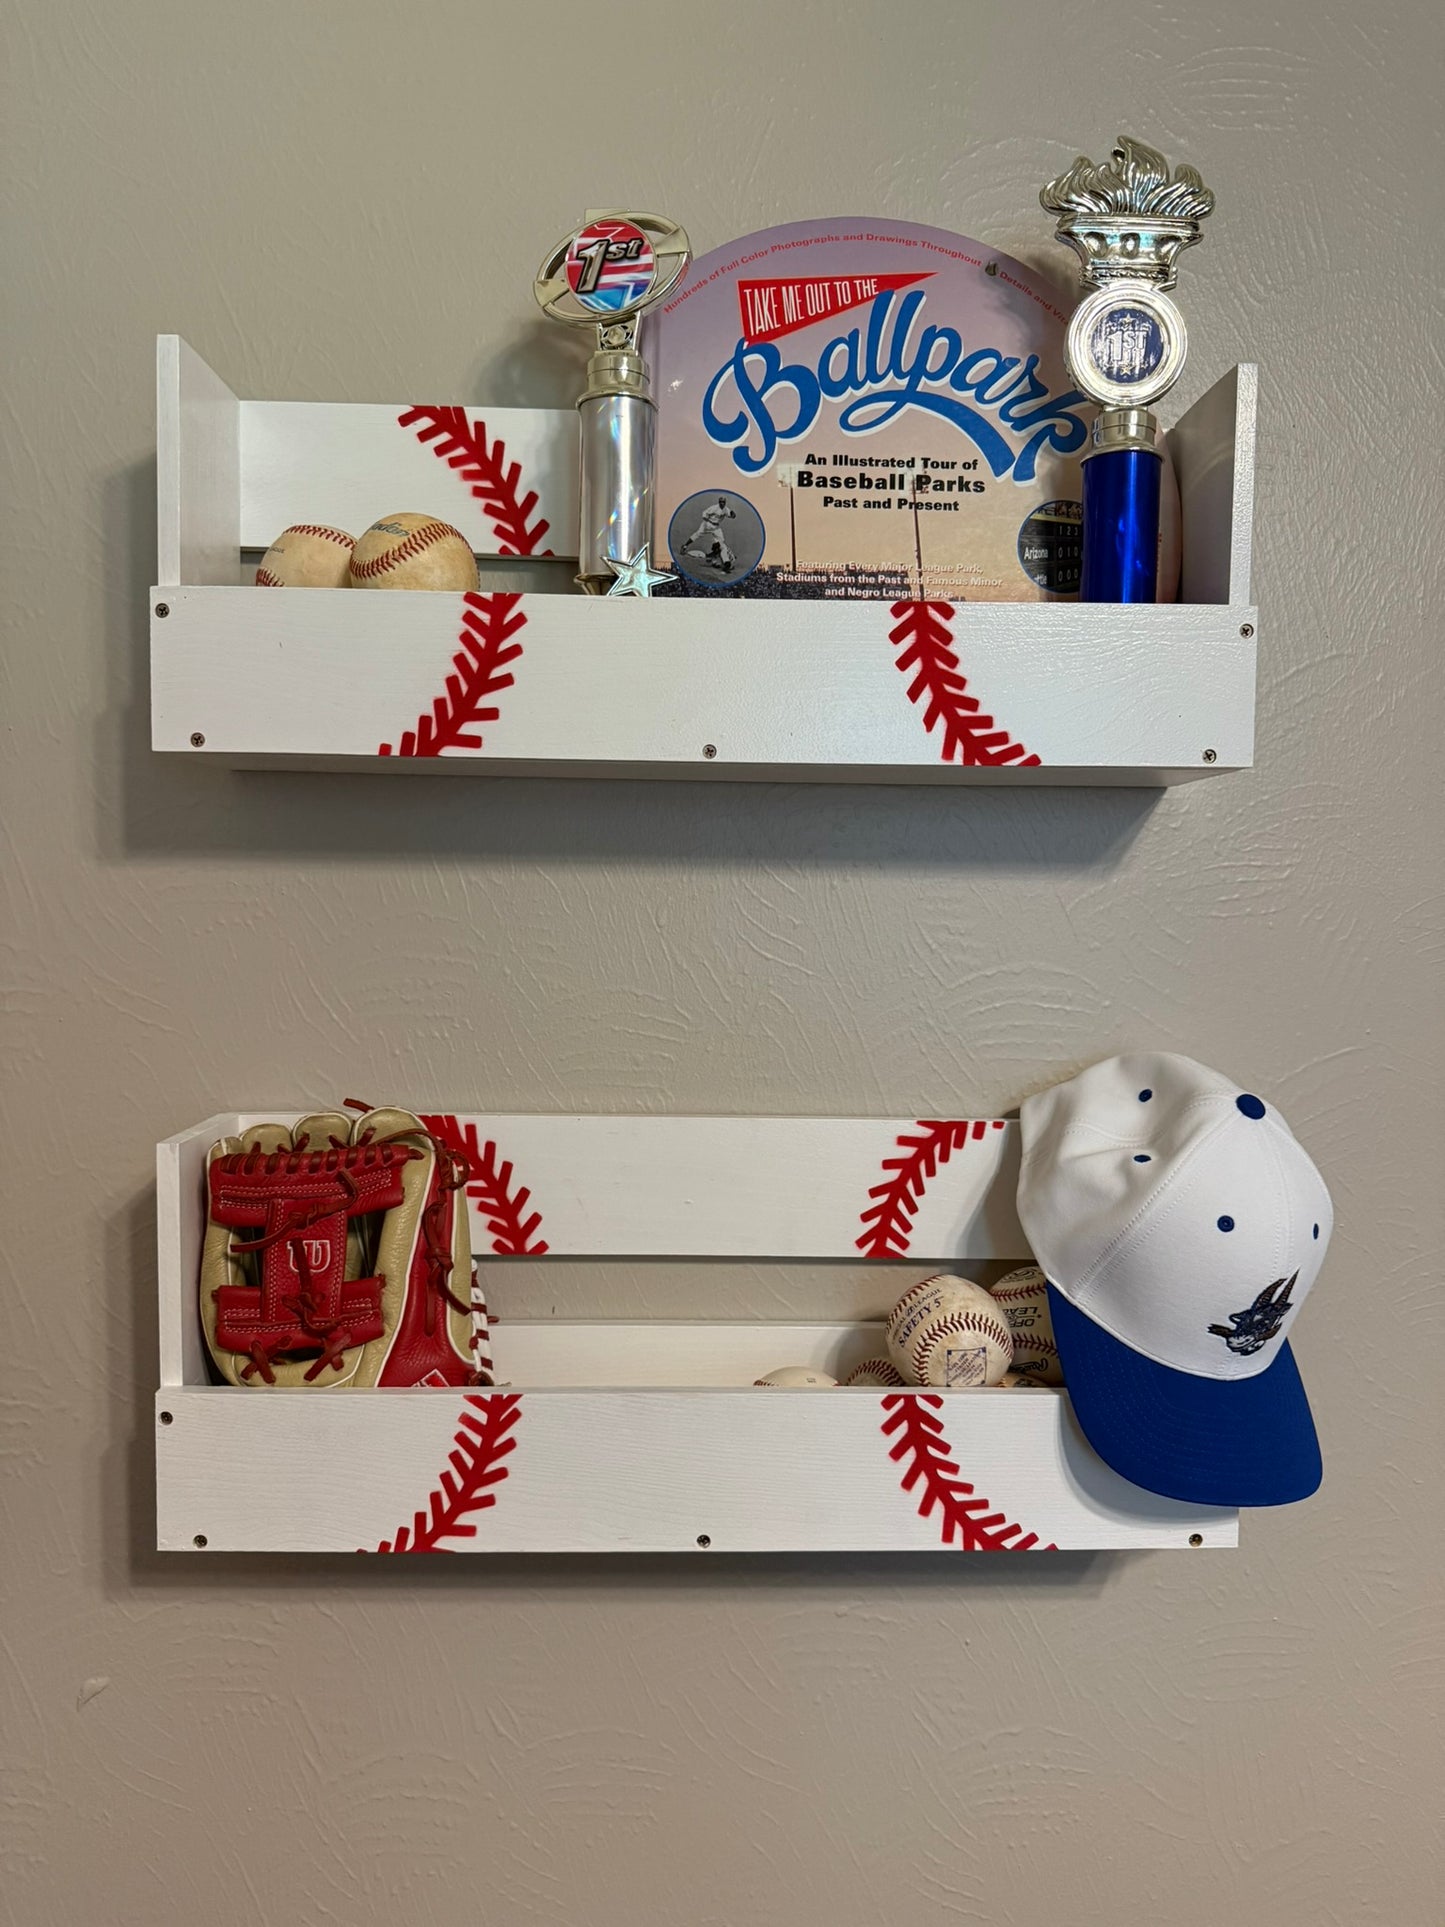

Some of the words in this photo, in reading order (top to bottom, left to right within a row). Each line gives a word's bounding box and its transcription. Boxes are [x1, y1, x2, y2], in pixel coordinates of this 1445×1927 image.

[575, 237, 644, 294] 1st
[663, 278, 708, 315] Hundreds
[709, 270, 720, 282] of
[720, 259, 740, 274] Full
[740, 249, 770, 265] Color
[770, 233, 841, 254] Photographs
[843, 232, 864, 242] and
[866, 233, 918, 248] Drawings
[921, 239, 982, 268] Throughout
[1000, 271, 1033, 298] Details
[1034, 294, 1053, 312] and
[743, 285, 782, 337] TAKE
[781, 283, 805, 326] ME
[804, 281, 832, 317] OUT
[833, 279, 853, 308] TO
[853, 278, 880, 301] THE
[1107, 330, 1148, 361] 1ST
[702, 289, 1092, 483] Ballpark
[805, 453, 827, 466] An
[832, 454, 916, 469] Illustrated
[921, 457, 958, 470] Tour
[962, 459, 979, 470] of
[797, 470, 905, 491] Baseball
[915, 474, 986, 494] Parks
[823, 496, 859, 508] Past
[863, 497, 892, 509] and
[897, 498, 960, 512] Present
[1023, 546, 1049, 561] Arizona
[776, 571, 828, 583] Stadiums
[830, 572, 856, 584] from
[857, 574, 876, 585] the
[878, 574, 902, 585] Past
[903, 575, 924, 585] and
[926, 576, 969, 587] Famous
[970, 576, 1004, 587] Minor
[795, 560, 846, 572] Featuring
[849, 561, 880, 573] Every
[881, 561, 913, 574] Major
[916, 562, 954, 574] League
[956, 563, 984, 575] Park,
[824, 586, 846, 597] and
[848, 587, 881, 599] Negro
[882, 587, 921, 599] League
[923, 588, 954, 599] Parks
[898, 1302, 932, 1349] SAFETY
